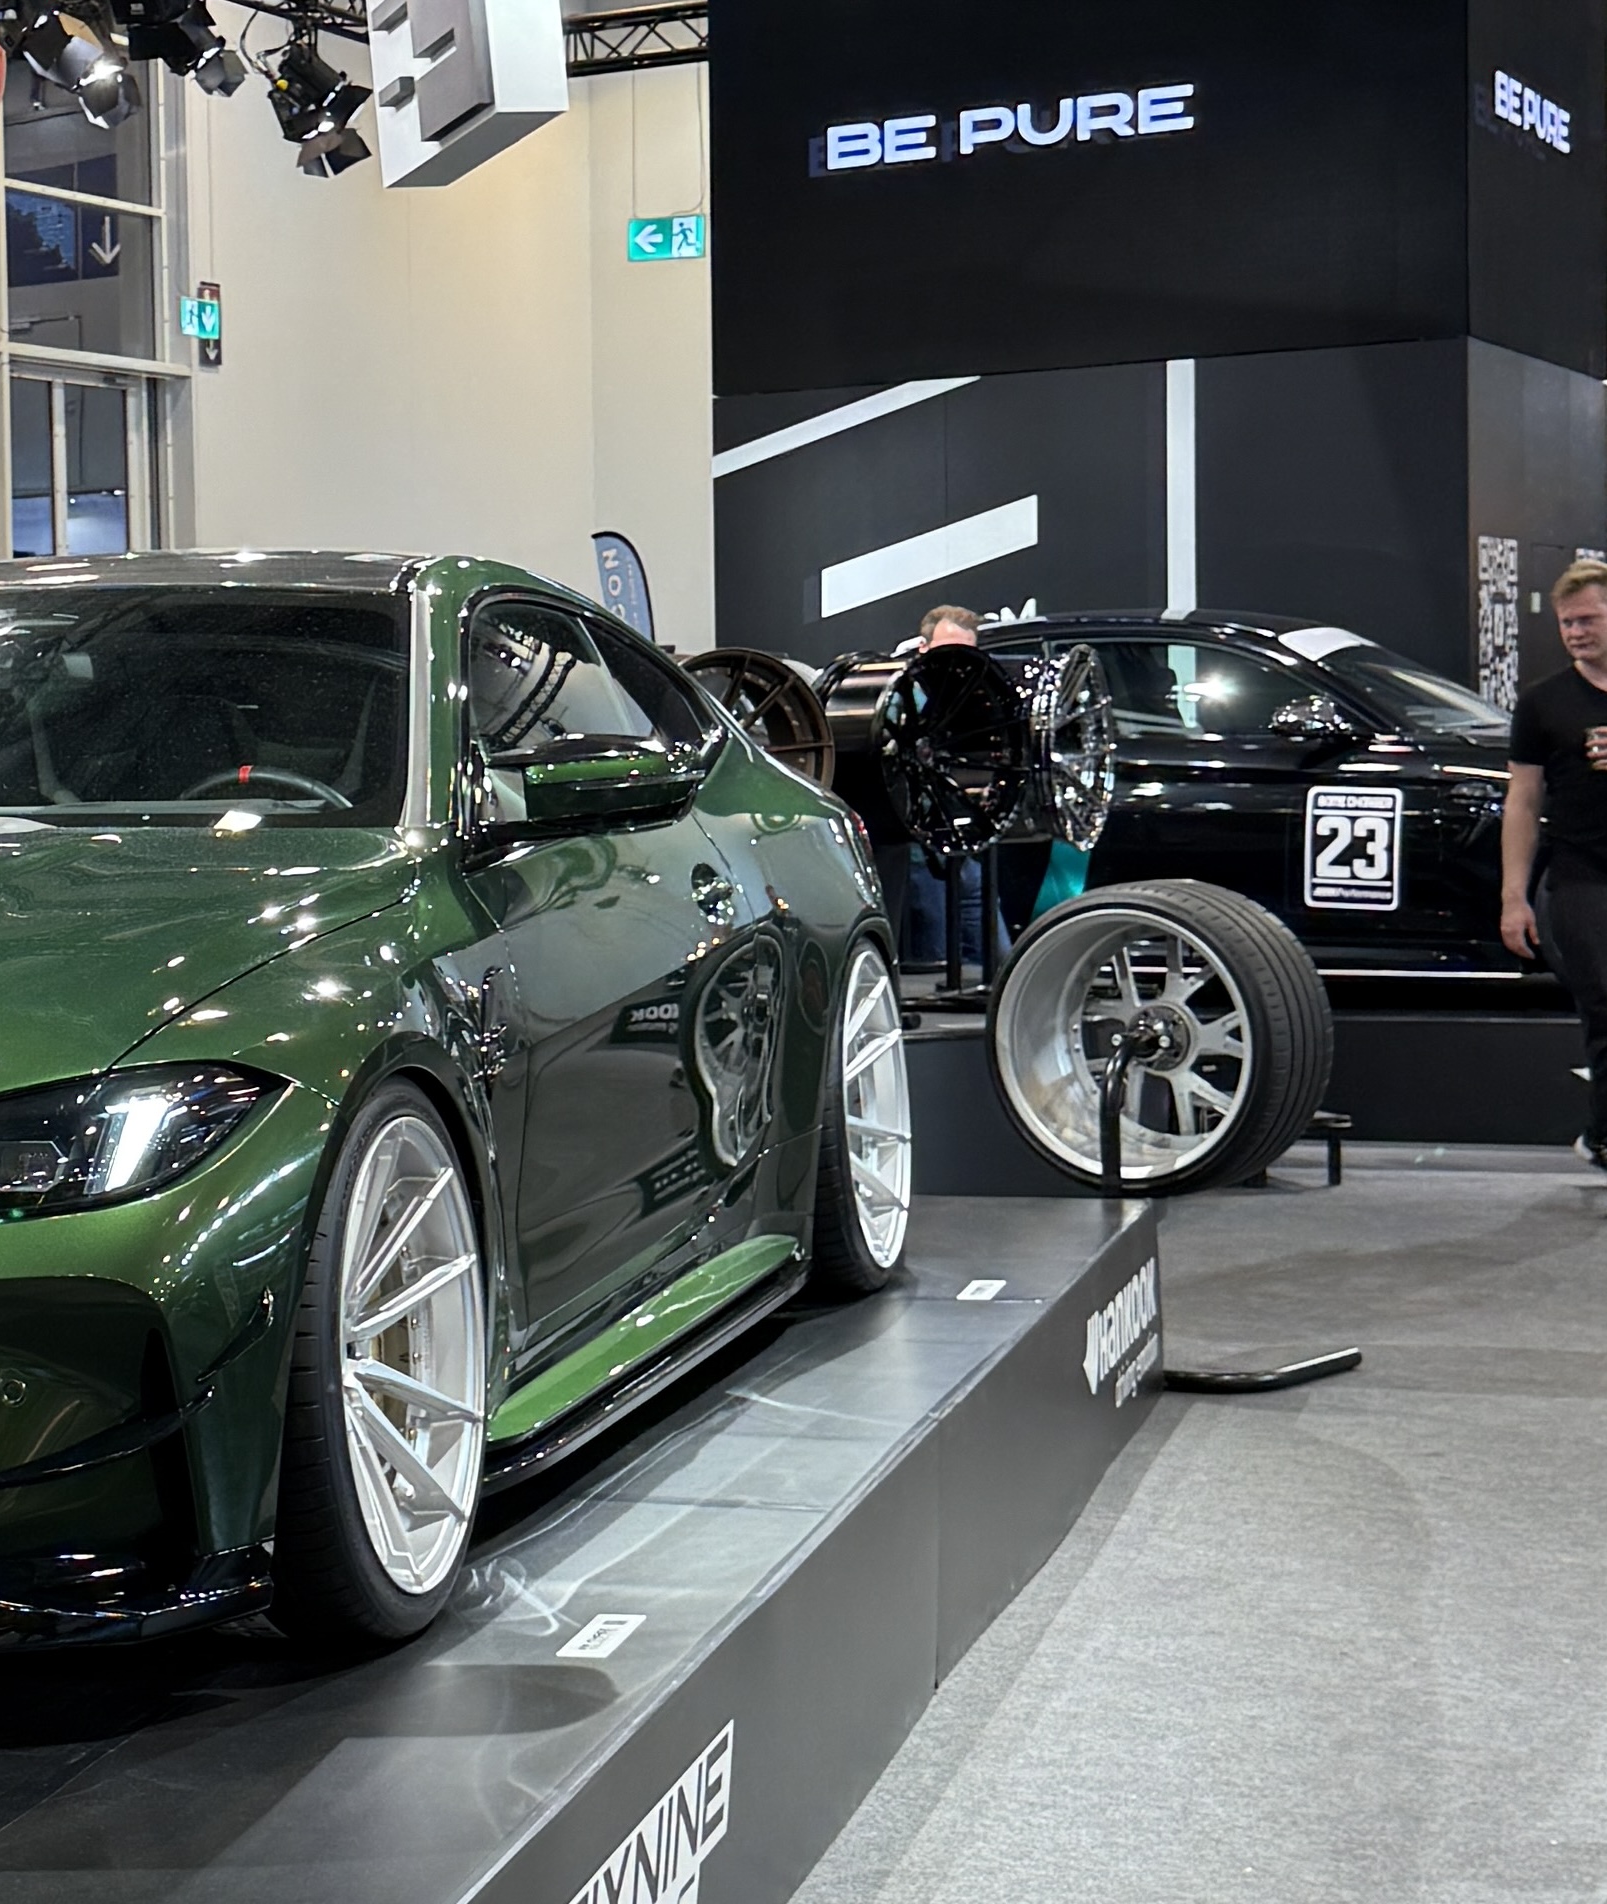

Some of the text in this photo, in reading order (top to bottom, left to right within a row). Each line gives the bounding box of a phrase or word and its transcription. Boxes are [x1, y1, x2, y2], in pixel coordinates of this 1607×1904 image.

[827, 83, 1194, 170] BE PURE
[1495, 70, 1570, 153] BE PURE
[1316, 816, 1389, 880] 23
